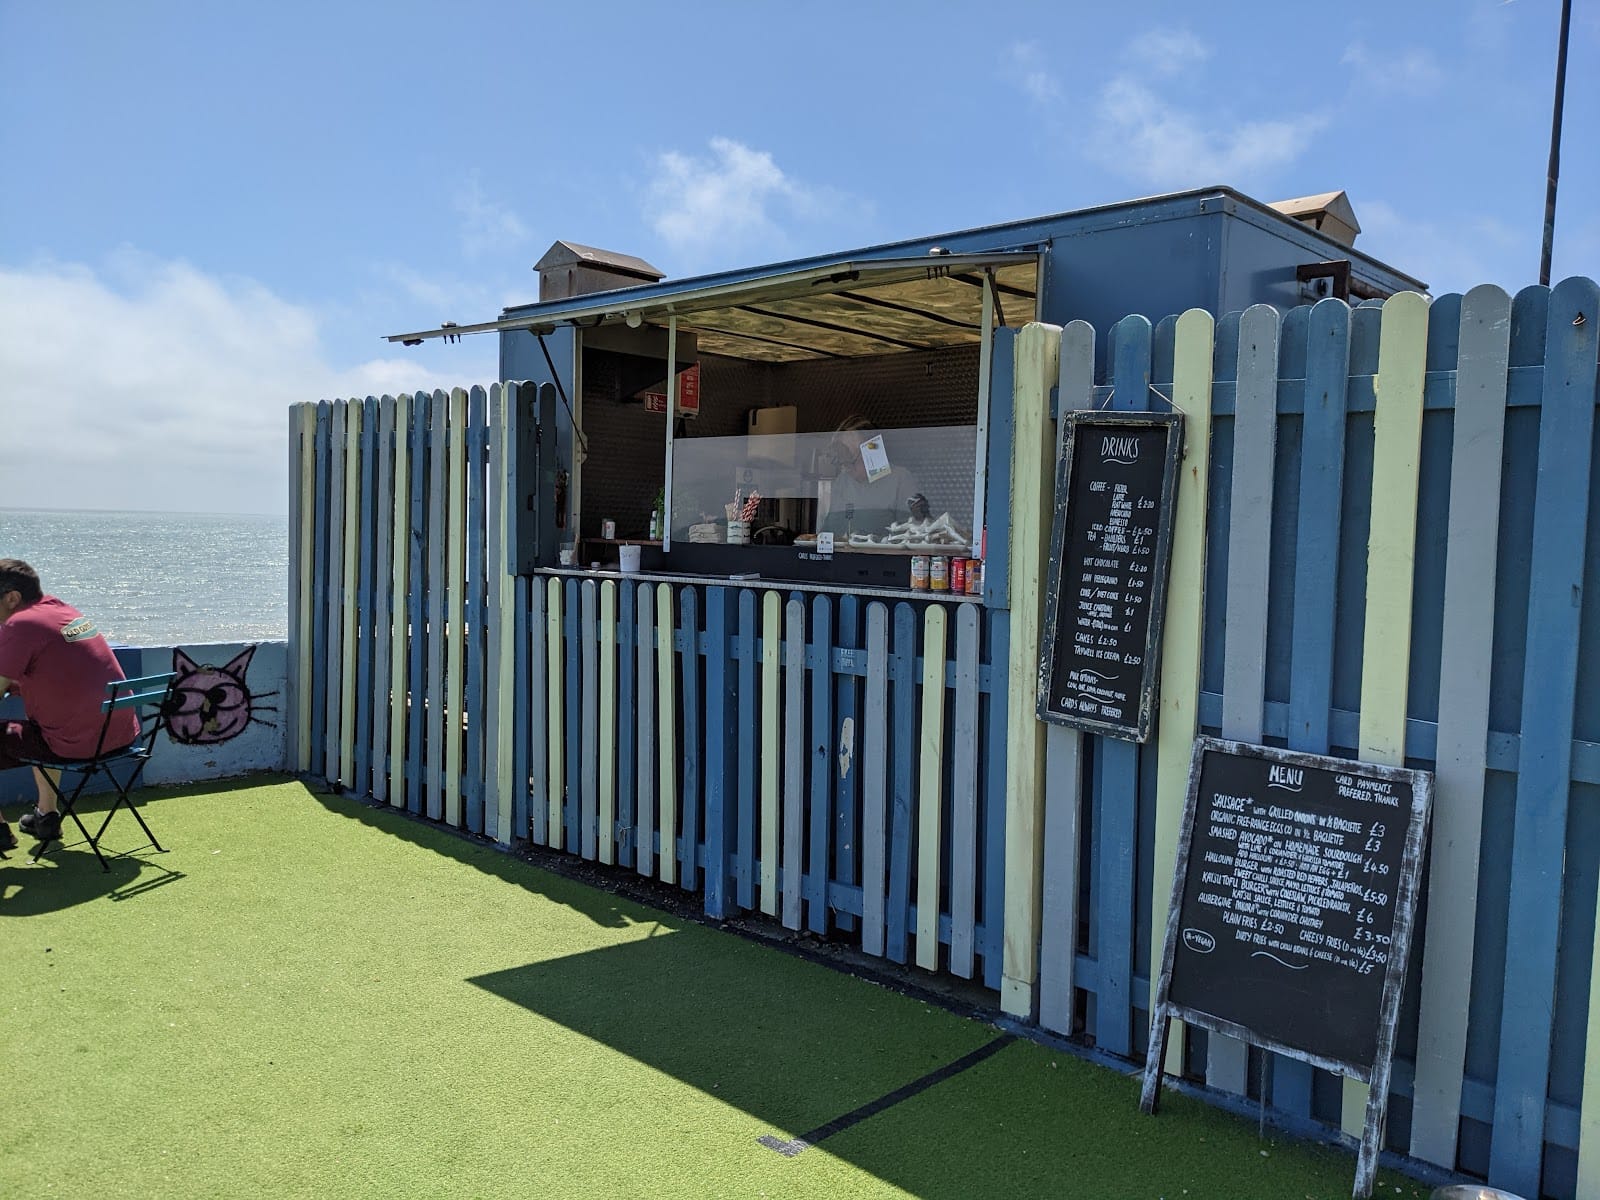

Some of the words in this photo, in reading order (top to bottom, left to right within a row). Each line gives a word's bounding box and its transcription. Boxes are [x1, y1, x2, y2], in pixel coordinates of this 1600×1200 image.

[1101, 437, 1139, 458] DRINKS
[1089, 481, 1107, 491] COFFEE
[1087, 531, 1097, 541] TEA
[1104, 525, 1126, 535] COFFEE
[1083, 557, 1094, 566] HOT
[1094, 558, 1119, 569] CHOCOLATE
[1075, 632, 1094, 644] CAKES
[1098, 634, 1118, 646] £2.50
[1103, 651, 1120, 662] CREAM
[1060, 697, 1078, 710] CARDS
[1079, 700, 1098, 714] ALWAYS
[1269, 765, 1303, 785] MENU
[1335, 776, 1352, 787] CARD
[1357, 780, 1392, 794] PAYMENTS
[1211, 810, 1237, 824] ORGANIC
[1270, 821, 1284, 835] EGGS
[1313, 830, 1345, 846] BAGUETTE
[1365, 837, 1381, 852] £3
[1268, 805, 1294, 821] GRILLED
[1333, 817, 1363, 834] BAGUETTE
[1369, 821, 1386, 838] £3
[1208, 825, 1237, 840] SMASHED
[1284, 840, 1320, 857] HOMEMADE
[1322, 847, 1364, 864] SOURDOUGH
[1363, 858, 1390, 875] £4.50
[1250, 844, 1262, 853] LIME
[1268, 847, 1298, 861] CORIANDER
[1205, 850, 1234, 866] HALLOUMI
[1234, 857, 1259, 872] BURGER
[1273, 866, 1297, 880] ROASTED
[1296, 871, 1307, 882] RED
[1362, 888, 1388, 906] £5.50
[1318, 866, 1330, 877] EGG
[1336, 870, 1350, 880] £1
[1233, 867, 1252, 879] SWEET
[1252, 872, 1268, 884] CHILLI
[1301, 883, 1321, 895] LETTUCE
[1324, 888, 1345, 901] TOMATO
[1202, 871, 1221, 884] KATSU
[1221, 874, 1239, 888] TOFU
[1308, 894, 1331, 909] PICKLED
[1357, 908, 1374, 924] £6
[1231, 888, 1252, 901] KATSU
[1274, 898, 1296, 911] LETTUCE
[1301, 904, 1321, 917] TOMATO
[1198, 892, 1233, 908] AUBERGINE
[1269, 909, 1299, 925] CORIANDER
[1298, 915, 1324, 930] CHUTNEY
[1353, 926, 1391, 945] £3.50
[1222, 911, 1242, 926] PLAIN
[1241, 915, 1258, 929] FRIES
[1260, 918, 1285, 935] £2.50
[1235, 929, 1252, 942] DIRTY
[1252, 933, 1268, 946] FRIES
[1314, 949, 1333, 962] CHEESE
[1358, 960, 1375, 975] £5
[1299, 929, 1325, 945] CHEESY
[1325, 935, 1342, 950] FRIES
[1365, 944, 1388, 964] £3.50
